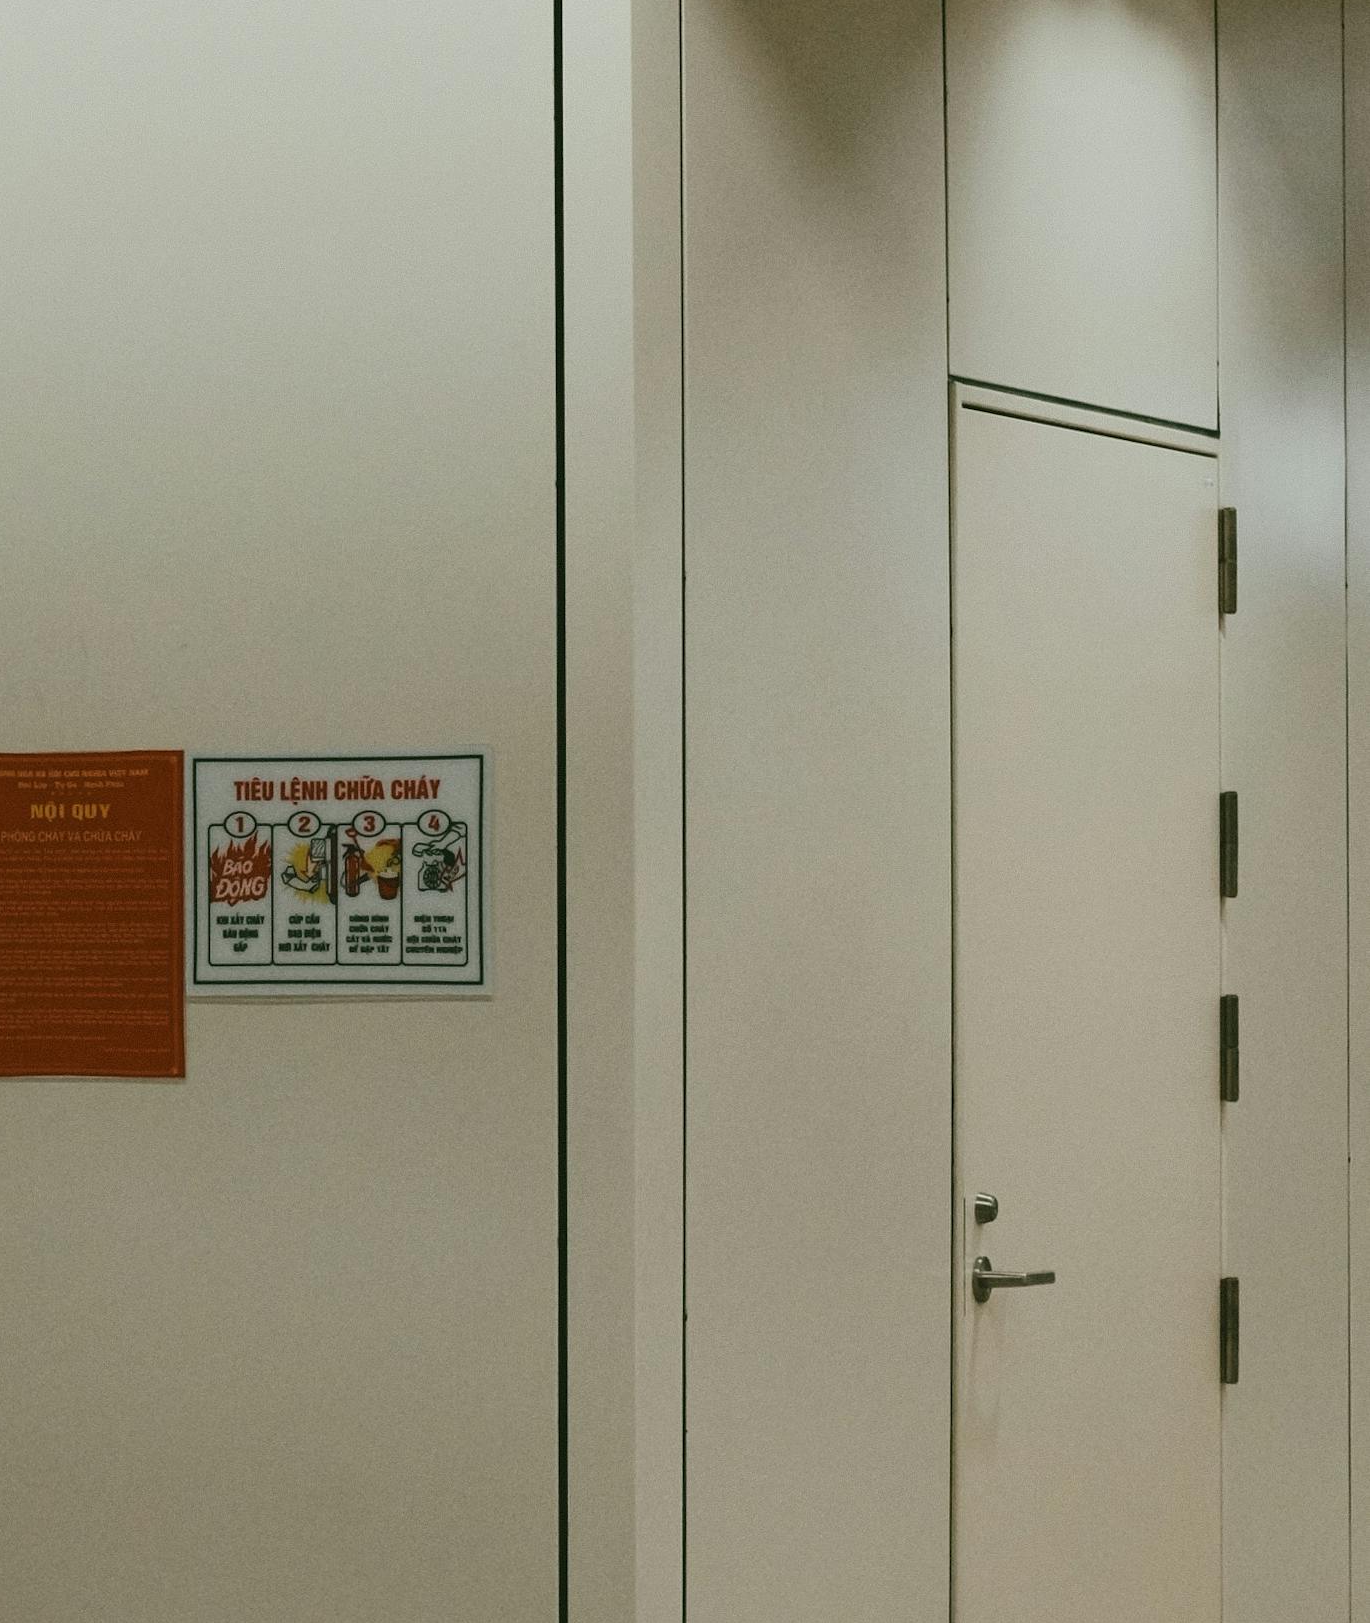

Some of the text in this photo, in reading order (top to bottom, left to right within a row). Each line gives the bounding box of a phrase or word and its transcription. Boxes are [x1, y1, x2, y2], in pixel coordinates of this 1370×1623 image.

[234, 775, 441, 805] TIÊU LỆNH CHỮA CHÁY
[30, 801, 111, 822] NỘI QUY
[234, 817, 244, 833] 1
[298, 816, 311, 833] 2
[364, 816, 376, 832] 3
[428, 815, 440, 831] 4
